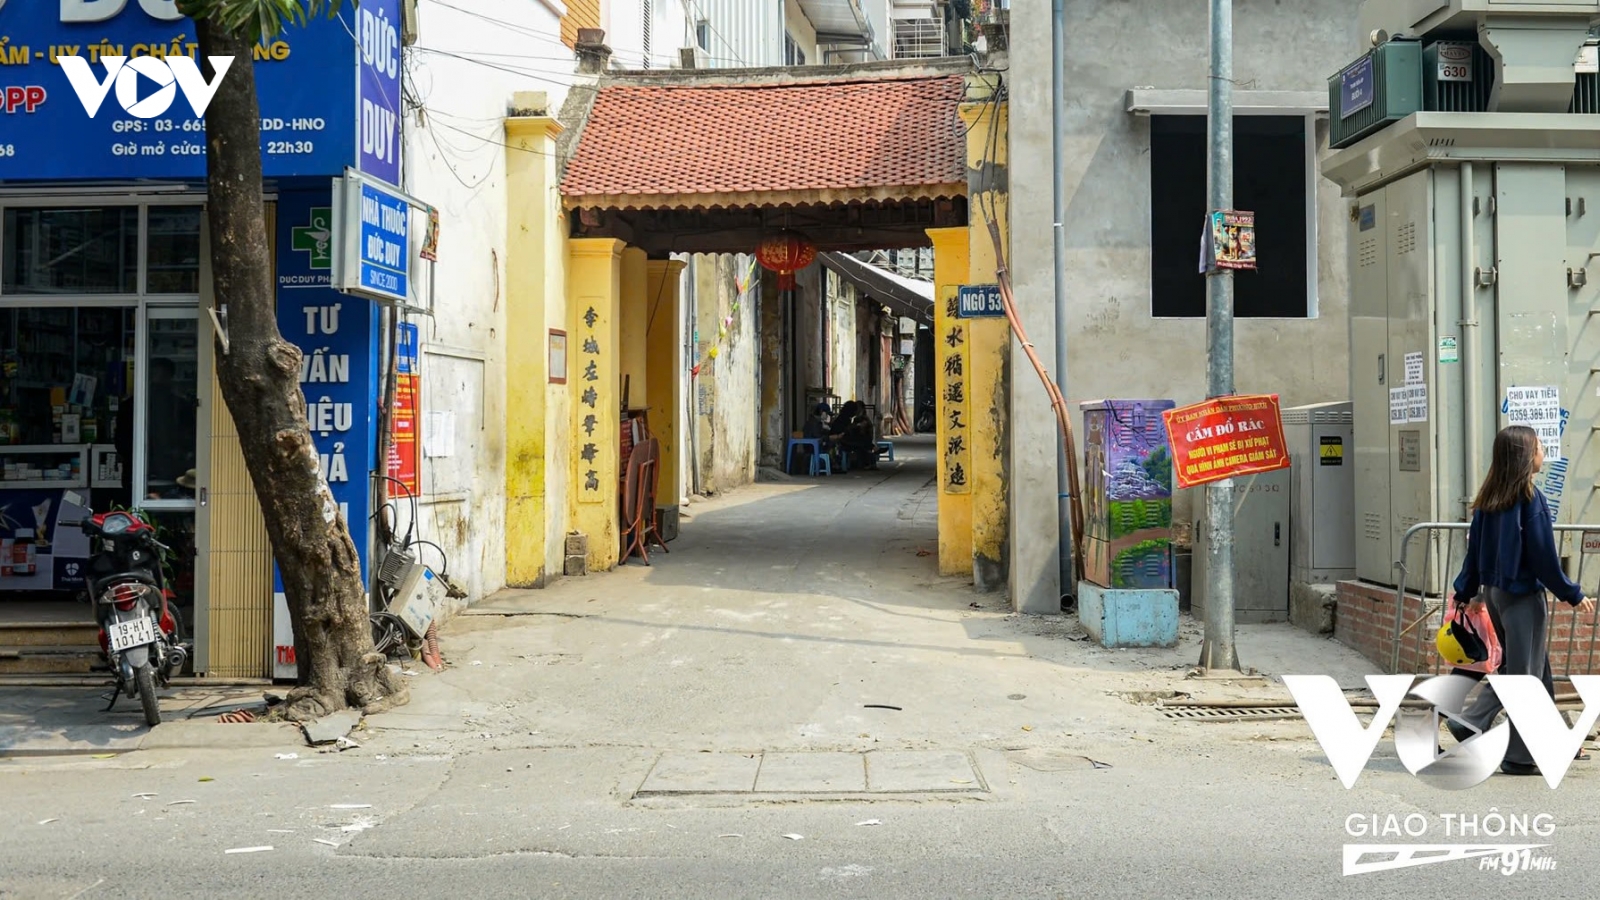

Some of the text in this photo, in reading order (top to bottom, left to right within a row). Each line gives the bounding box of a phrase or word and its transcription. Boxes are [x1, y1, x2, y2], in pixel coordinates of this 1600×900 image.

[362, 7, 397, 80] ĐỨC
[1443, 65, 1467, 78] 630
[111, 120, 149, 133] GPS:
[362, 98, 396, 165] DUY
[111, 140, 314, 156] Giờ mở cửa: 22h30
[361, 195, 380, 227] NHÀ
[380, 202, 407, 237] THUỐC
[367, 231, 384, 262] ĐỨC
[384, 242, 401, 268] DUY
[369, 269, 399, 292] SINCE 2000
[962, 289, 1005, 311] NGÕ 53
[303, 303, 342, 335] TƯ
[1508, 390, 1524, 400] CHO
[1525, 389, 1539, 399] VAY
[306, 396, 352, 437] IỆU
[1186, 417, 1266, 443] CẤM ĐỔ RÁC
[1188, 446, 1206, 460] NGƯỜI
[1206, 446, 1213, 456] VI
[1212, 443, 1230, 456] PHẠM
[1254, 437, 1270, 448] PHẠT
[1186, 447, 1277, 476] QUA HÌNH ẢNH CAMERA GIÁM SÁT
[115, 631, 151, 648] 101.41
[118, 621, 145, 635] 19-H1
